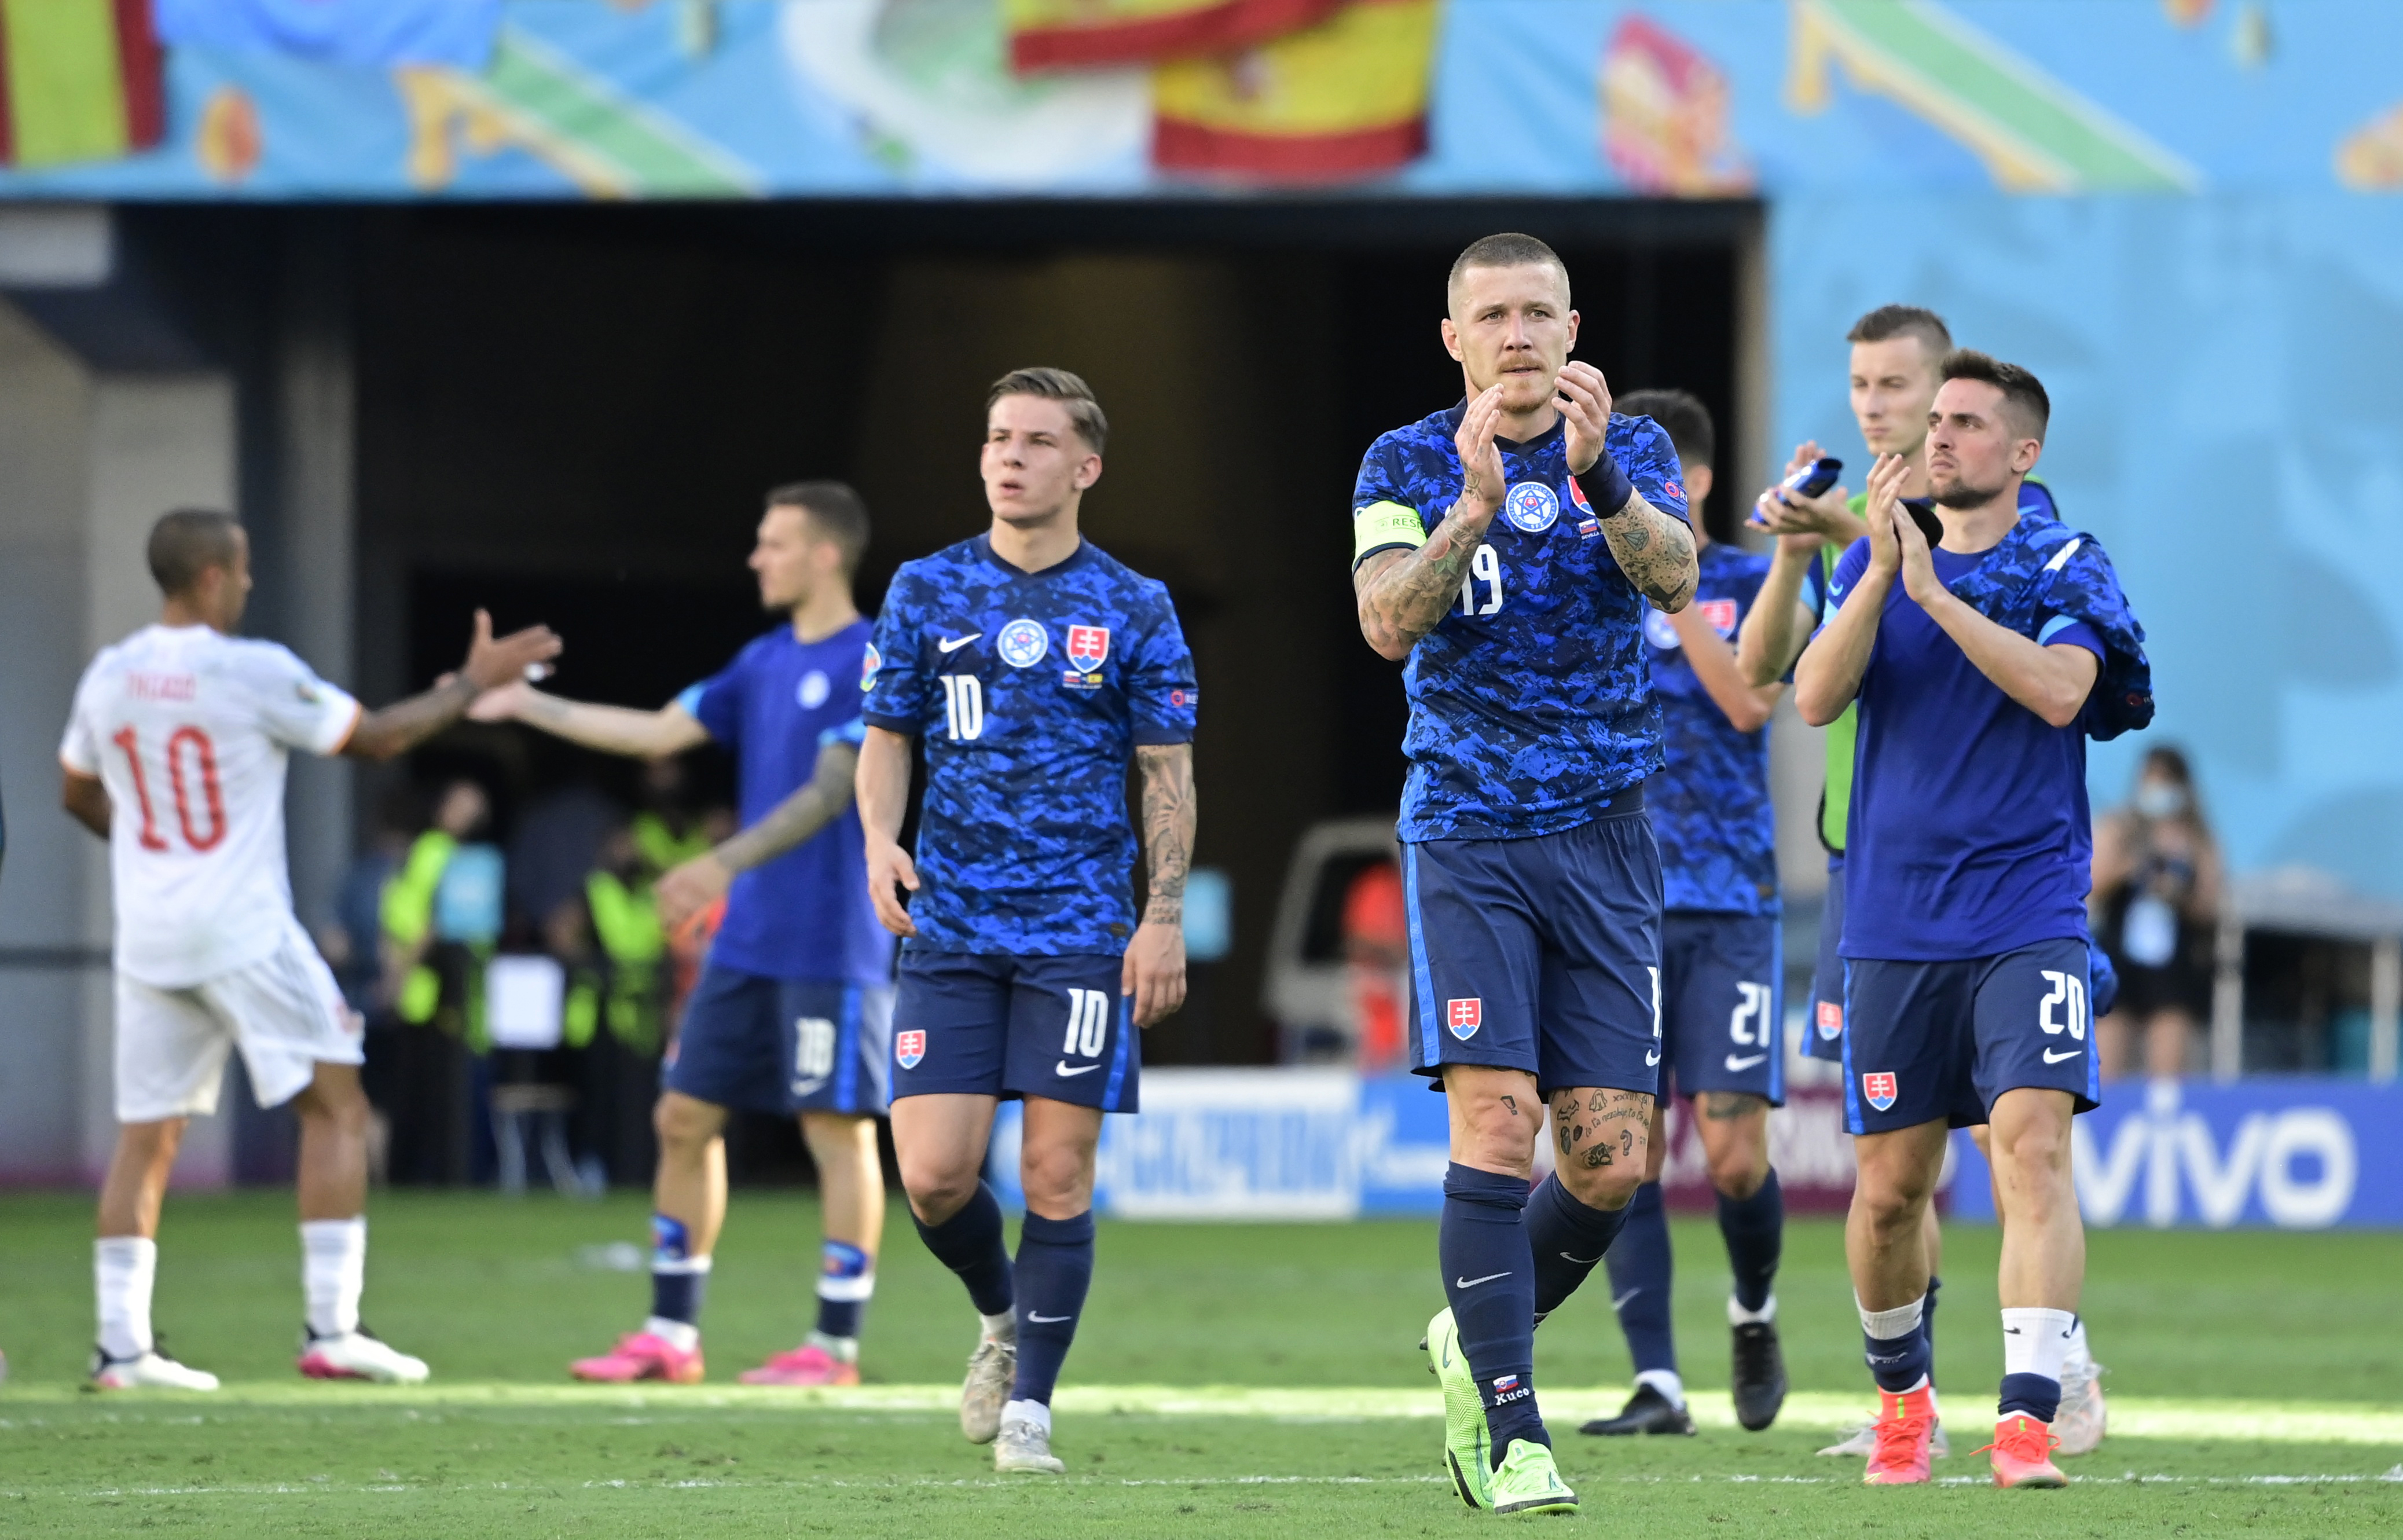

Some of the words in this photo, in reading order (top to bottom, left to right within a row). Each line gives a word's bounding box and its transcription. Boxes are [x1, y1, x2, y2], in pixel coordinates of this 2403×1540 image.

[1582, 531, 1599, 540] SEVILLA
[1462, 544, 1503, 616] 19
[939, 674, 983, 740] 10
[113, 724, 226, 854] 10
[1063, 988, 1109, 1057] 10
[1730, 981, 1771, 1047] 21
[2039, 970, 2085, 1040] 20
[2071, 1078, 2360, 1229] vivo
[1494, 1388, 1529, 1406] Kuco
